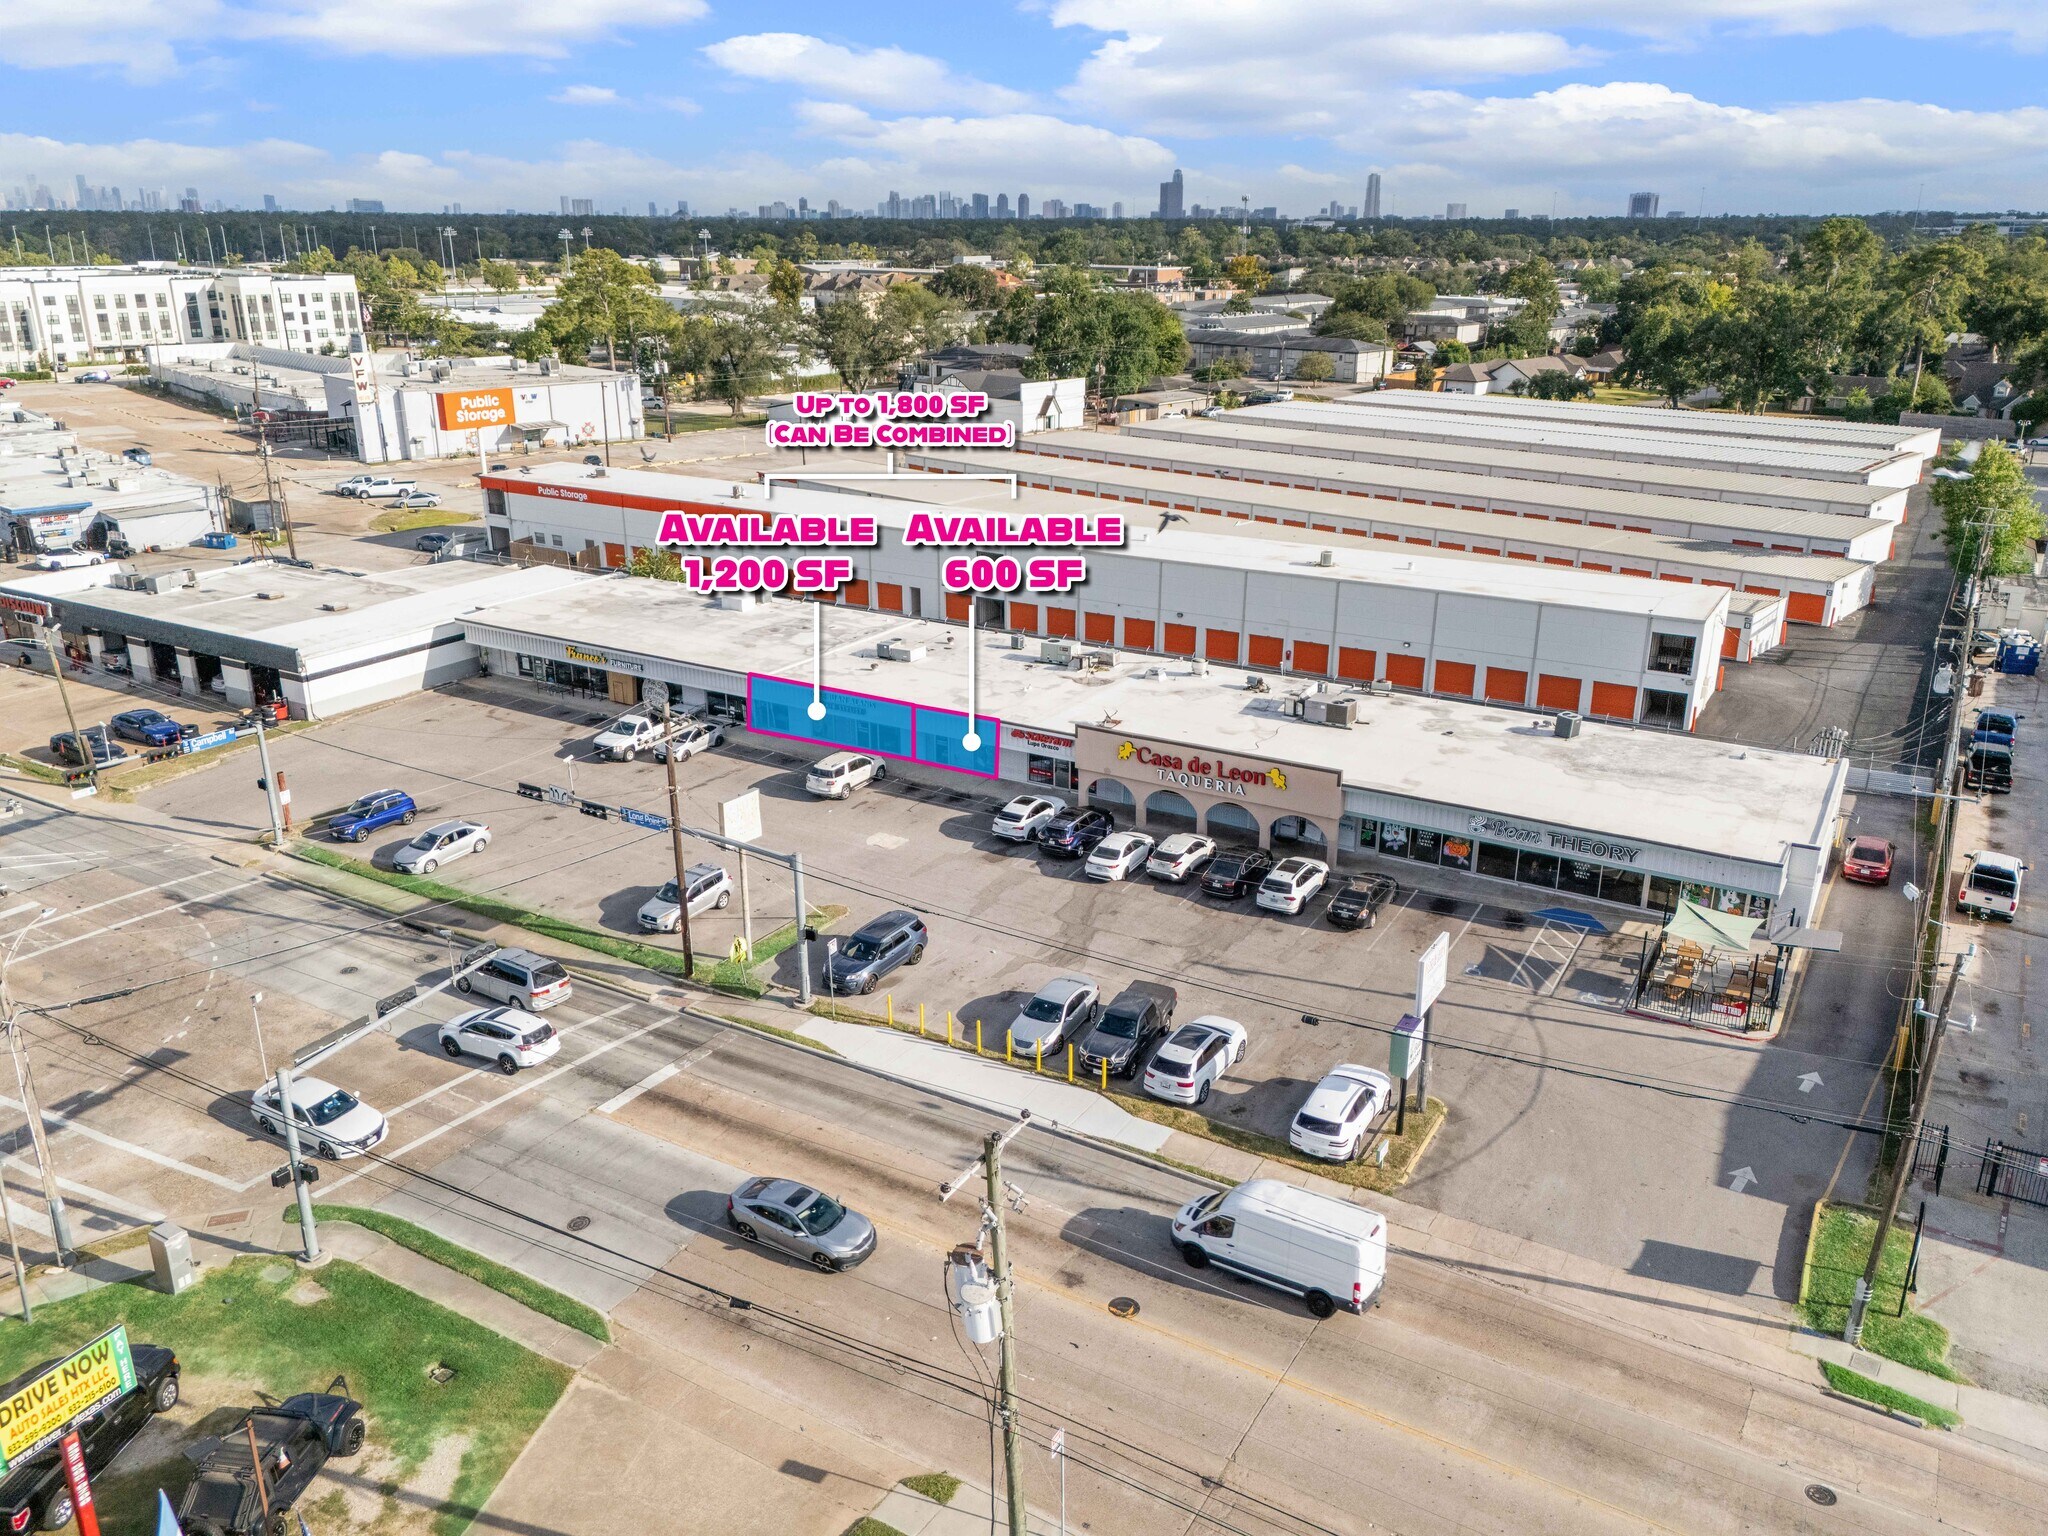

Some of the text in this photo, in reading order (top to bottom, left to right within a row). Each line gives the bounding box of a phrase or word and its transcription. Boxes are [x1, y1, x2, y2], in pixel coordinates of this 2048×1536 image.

[353, 357, 368, 391] VFW
[460, 394, 500, 409] Public
[456, 408, 506, 422] Storage
[538, 485, 588, 502] Public Storage
[611, 660, 643, 671] FURNITURE
[191, 731, 227, 747] Campbell
[1136, 747, 1267, 786] Casa de Leon
[1157, 768, 1246, 796] TAQUERIA
[629, 811, 644, 824] Long
[644, 814, 661, 826] Point
[1491, 819, 1641, 863] Bean THEORY
[1712, 1003, 1742, 1017] DRIVE THRU
[113, 1331, 124, 1355] PAY
[0, 1340, 109, 1428] DRIVE NOW
[120, 1357, 132, 1388] HERE
[10, 1366, 110, 1440] AUTO SALES HTX LLC
